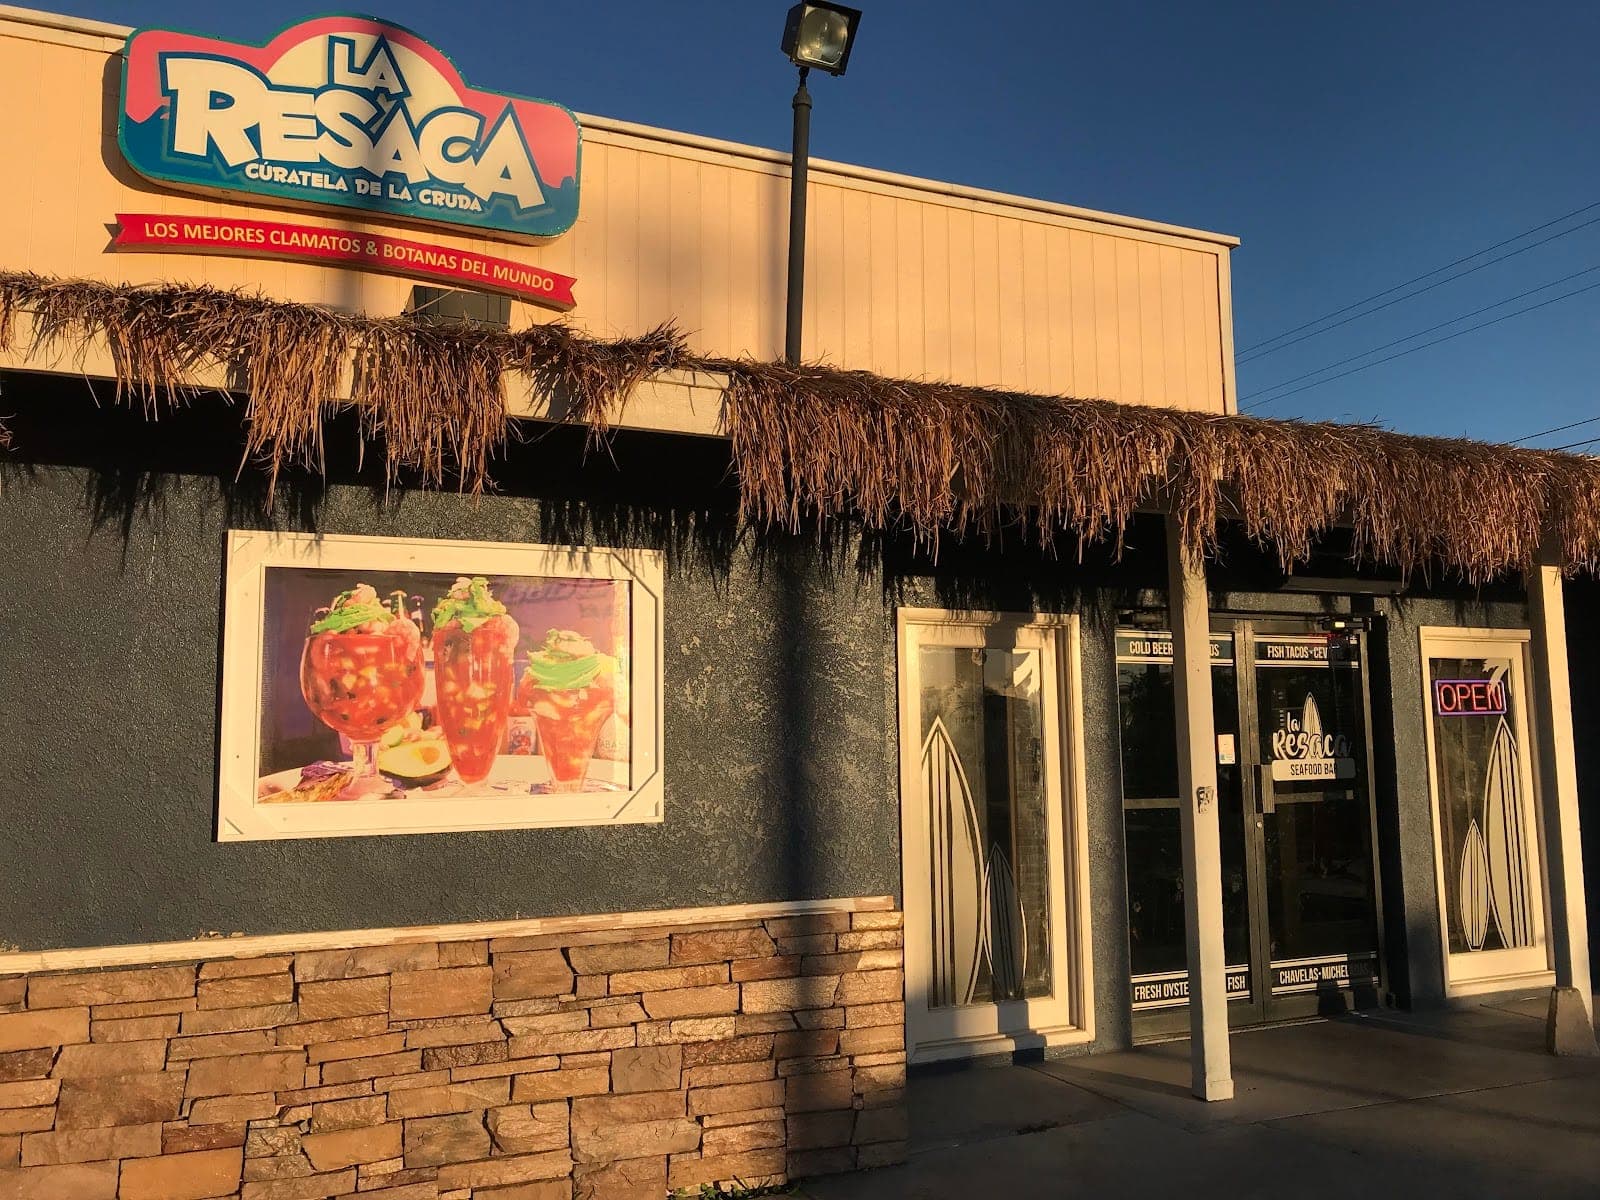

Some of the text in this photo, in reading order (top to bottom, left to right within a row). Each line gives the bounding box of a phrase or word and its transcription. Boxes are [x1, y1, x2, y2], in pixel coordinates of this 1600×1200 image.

[331, 37, 406, 96] LA
[163, 54, 548, 210] RESACA
[244, 161, 483, 212] CÚRATELA DE LA CRUDA
[144, 222, 555, 292] LOS MEJORES CLAMATOS & BOTANAS DEL MUNDO
[1129, 640, 1220, 657] COLD BEER OS
[1267, 645, 1328, 660] FISH TACOS CEV
[1439, 683, 1503, 711] OPEN
[1286, 711, 1301, 734] la
[1290, 763, 1322, 776] SEAFOOD
[1134, 975, 1246, 1001] FRESH OYSTE FISH
[1279, 966, 1319, 985] CHAVELAS
